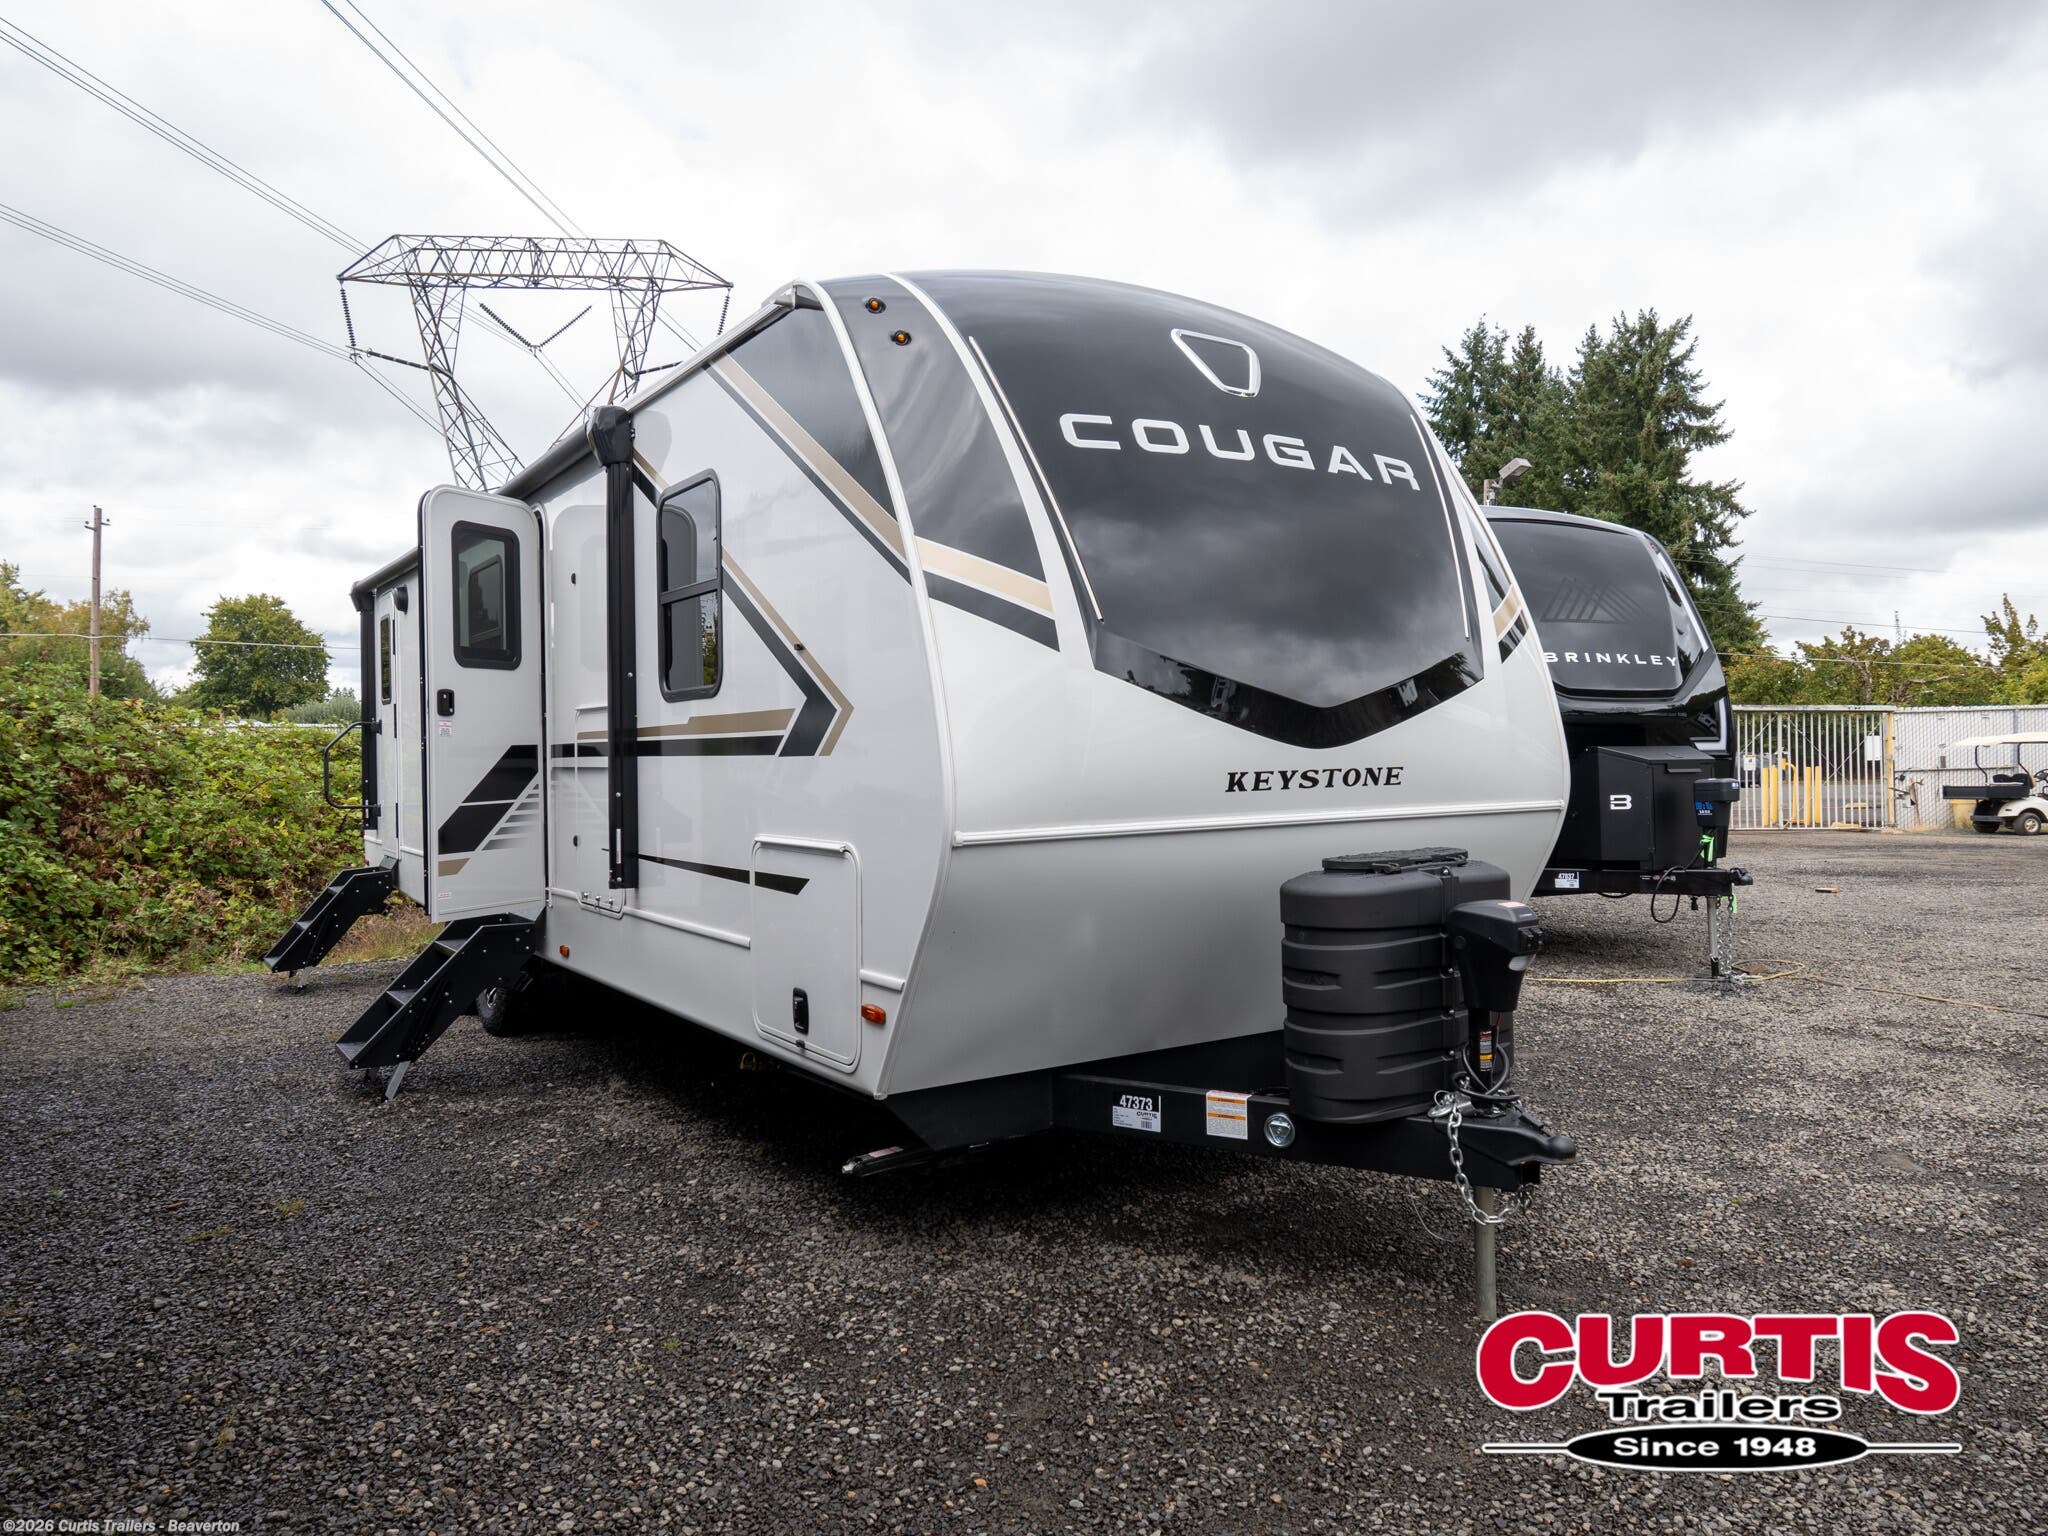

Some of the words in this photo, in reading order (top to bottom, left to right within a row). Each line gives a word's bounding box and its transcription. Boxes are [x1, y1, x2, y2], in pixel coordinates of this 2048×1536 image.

[1059, 413, 1421, 491] COUGAR
[1543, 651, 1677, 667] BRINKLEY
[1225, 766, 1404, 793] KEYSTONE
[1120, 1094, 1153, 1111] 47373
